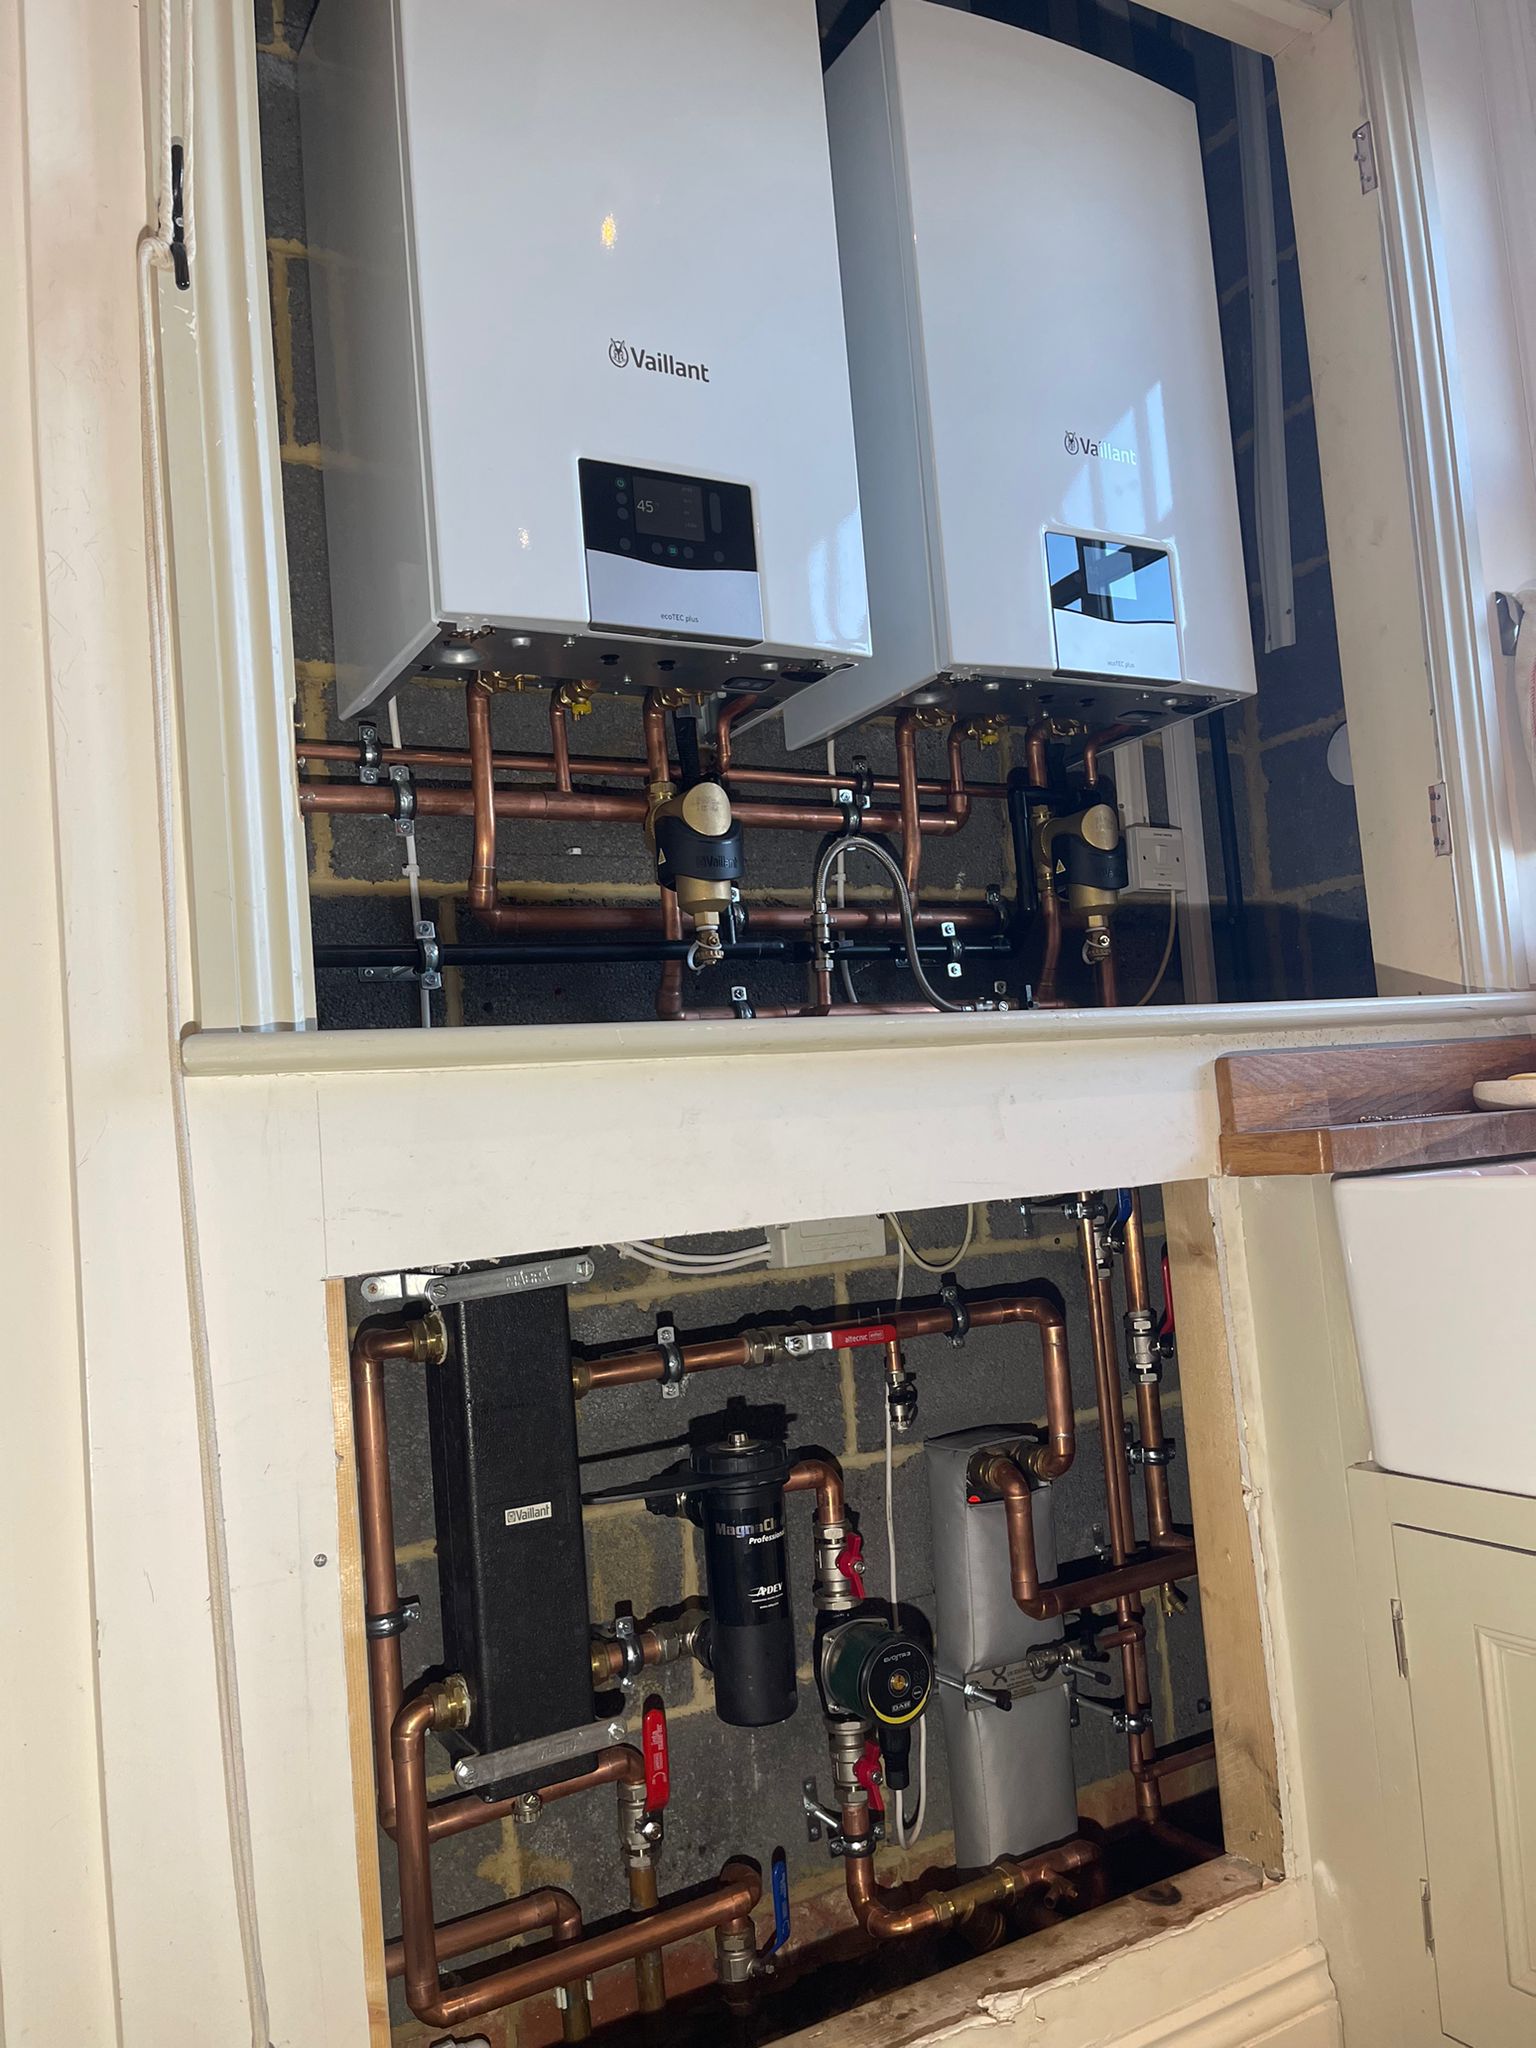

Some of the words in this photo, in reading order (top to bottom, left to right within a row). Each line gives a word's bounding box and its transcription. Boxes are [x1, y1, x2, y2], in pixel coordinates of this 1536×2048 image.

[630, 346, 710, 383] Vaillant
[1080, 437, 1137, 466] Vaillant
[660, 613, 684, 621] ecoTEC
[685, 615, 699, 623] plus
[516, 1504, 549, 1521] Vaillant
